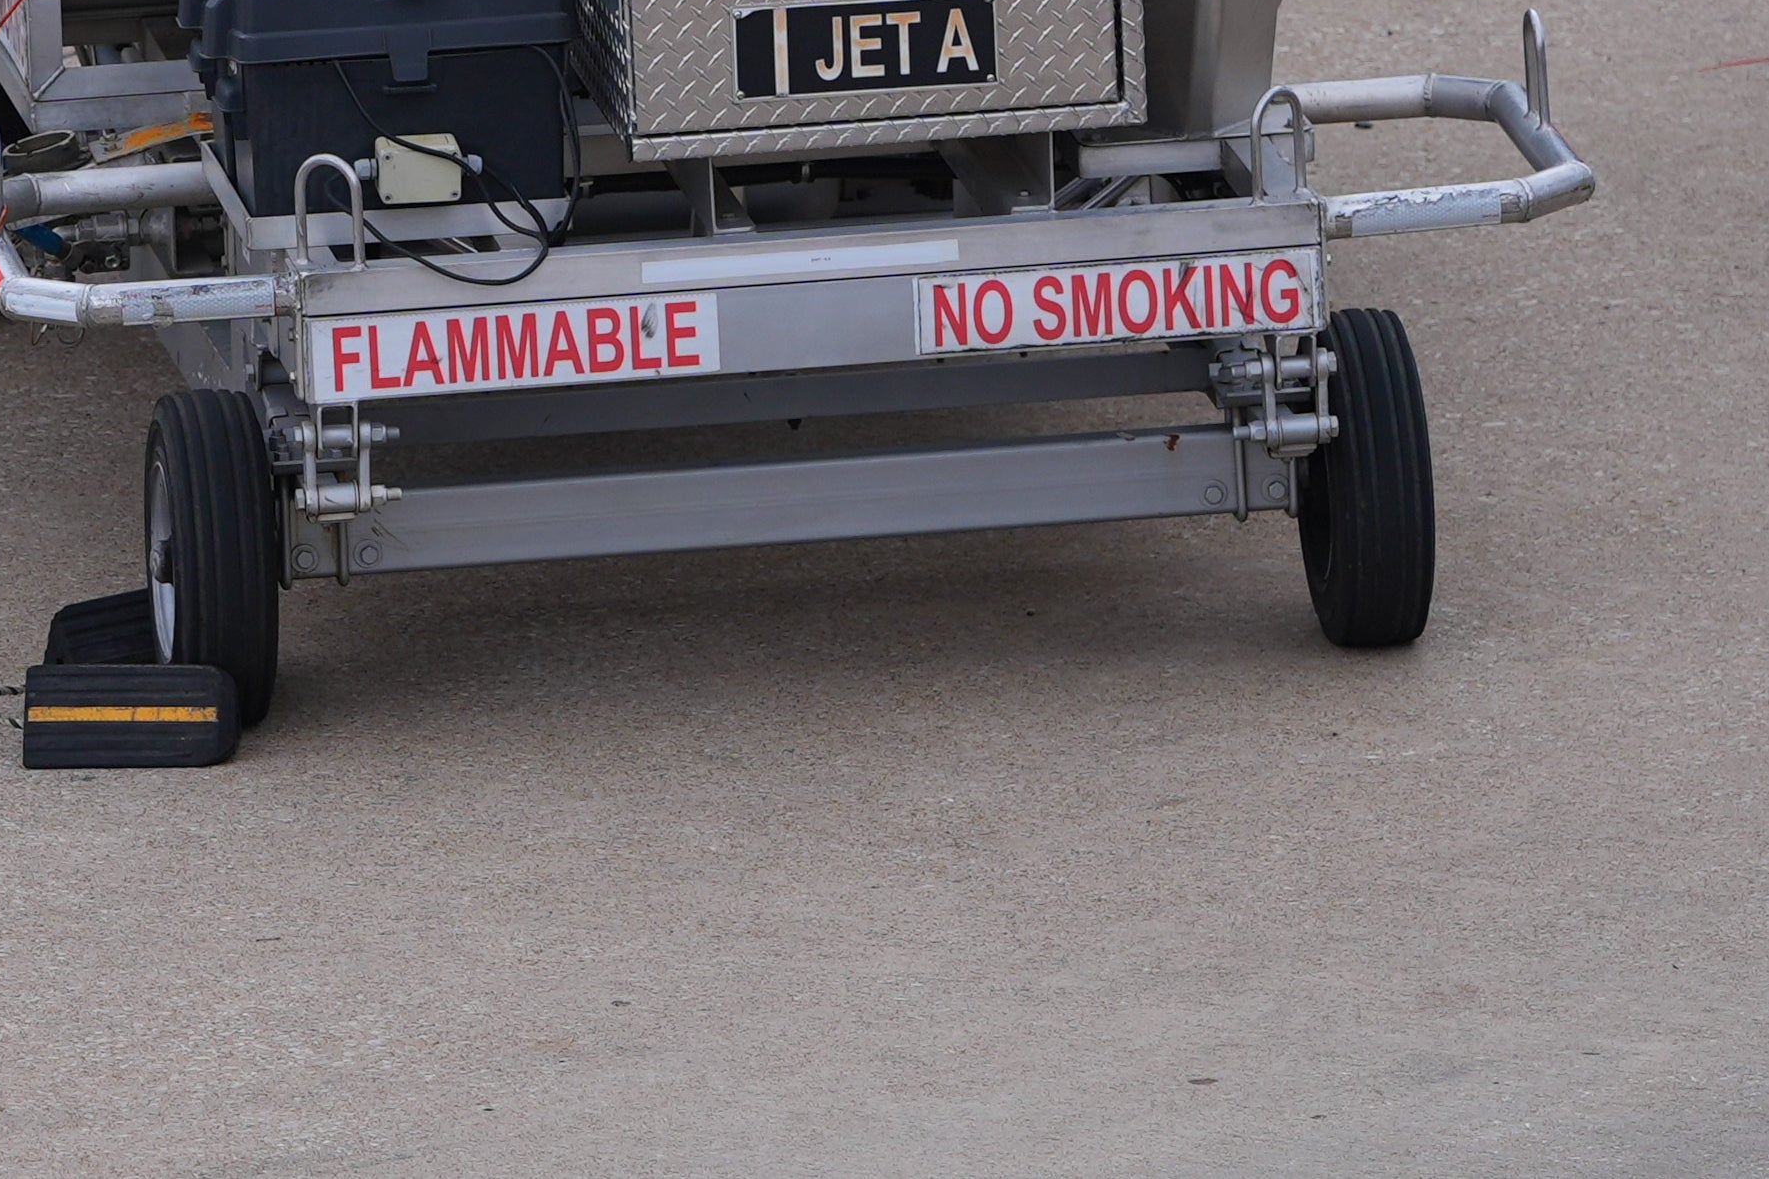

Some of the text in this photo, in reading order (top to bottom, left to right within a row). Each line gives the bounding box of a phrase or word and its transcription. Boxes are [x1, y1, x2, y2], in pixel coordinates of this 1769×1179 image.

[815, 7, 980, 82] JET A
[331, 300, 701, 393] FLAMMABLE
[932, 258, 1301, 348] NO SMOKING
